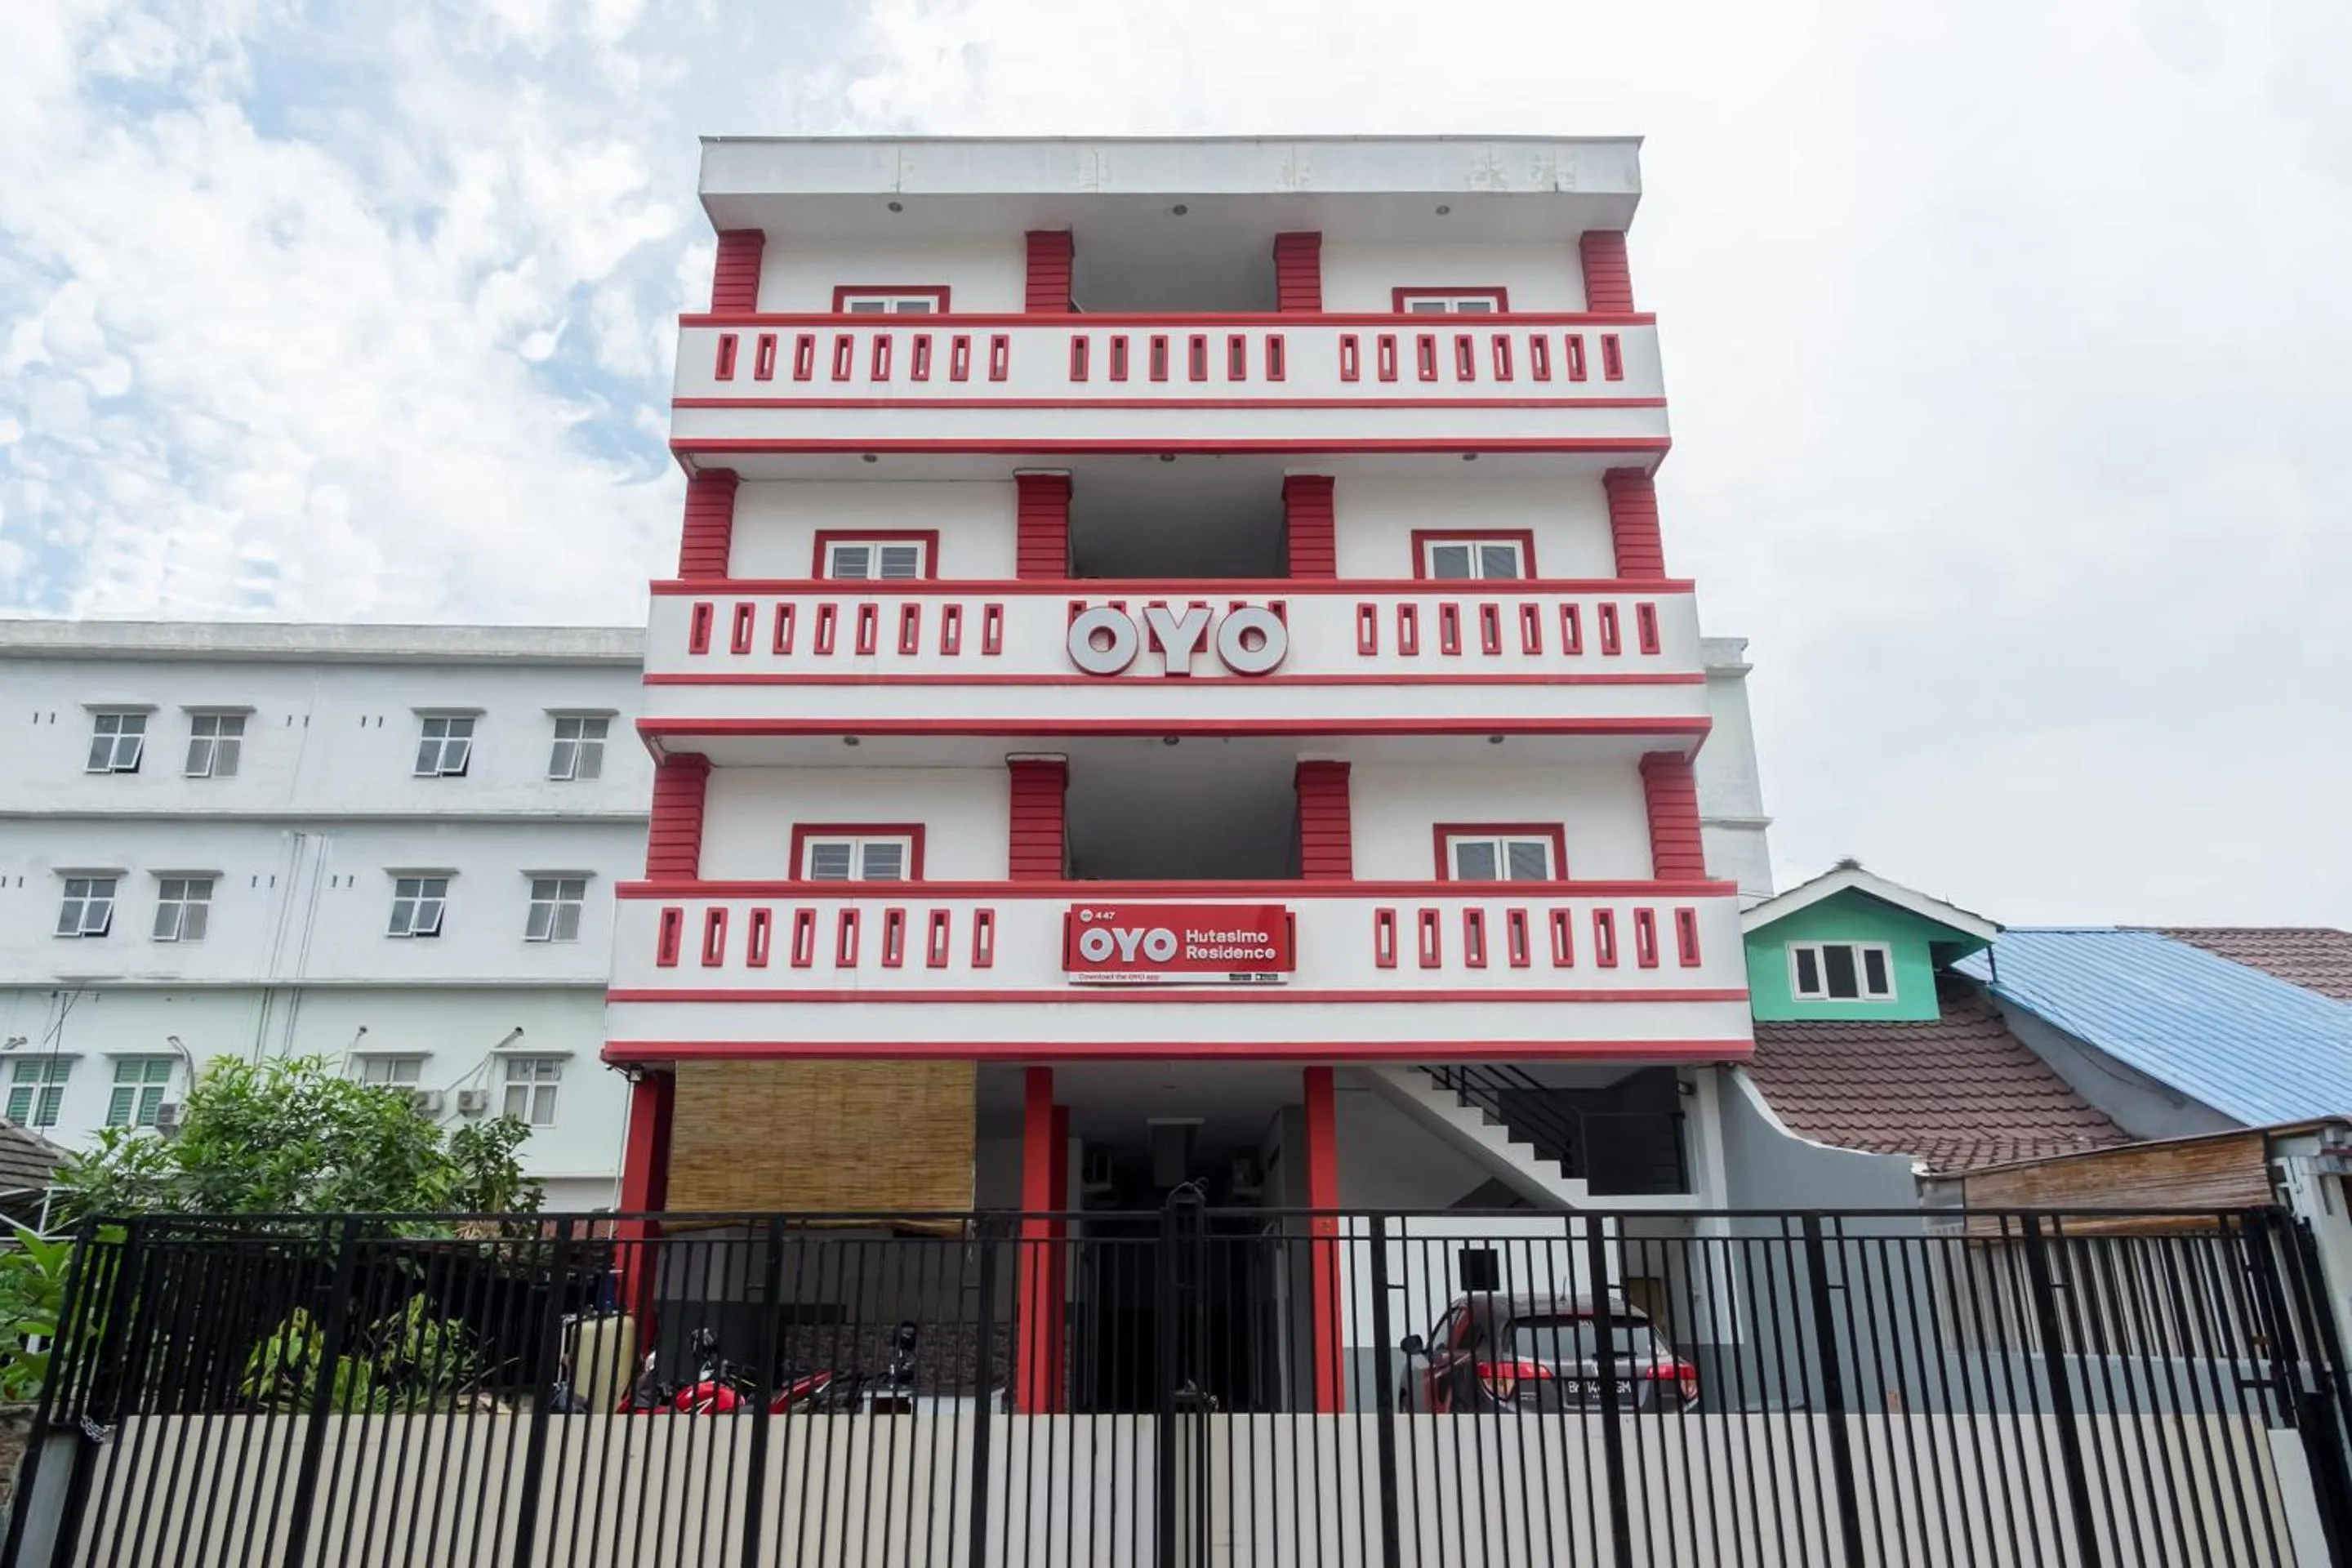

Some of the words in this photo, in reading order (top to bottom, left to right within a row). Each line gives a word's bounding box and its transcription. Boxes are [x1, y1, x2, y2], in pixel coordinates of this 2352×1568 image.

[1067, 605, 1290, 677] OYO
[1095, 911, 1116, 920] 447
[1186, 929, 1268, 943] Hutasimo
[1080, 928, 1178, 962] OYO
[1186, 945, 1276, 960] Residence
[1079, 973, 1114, 981] Download
